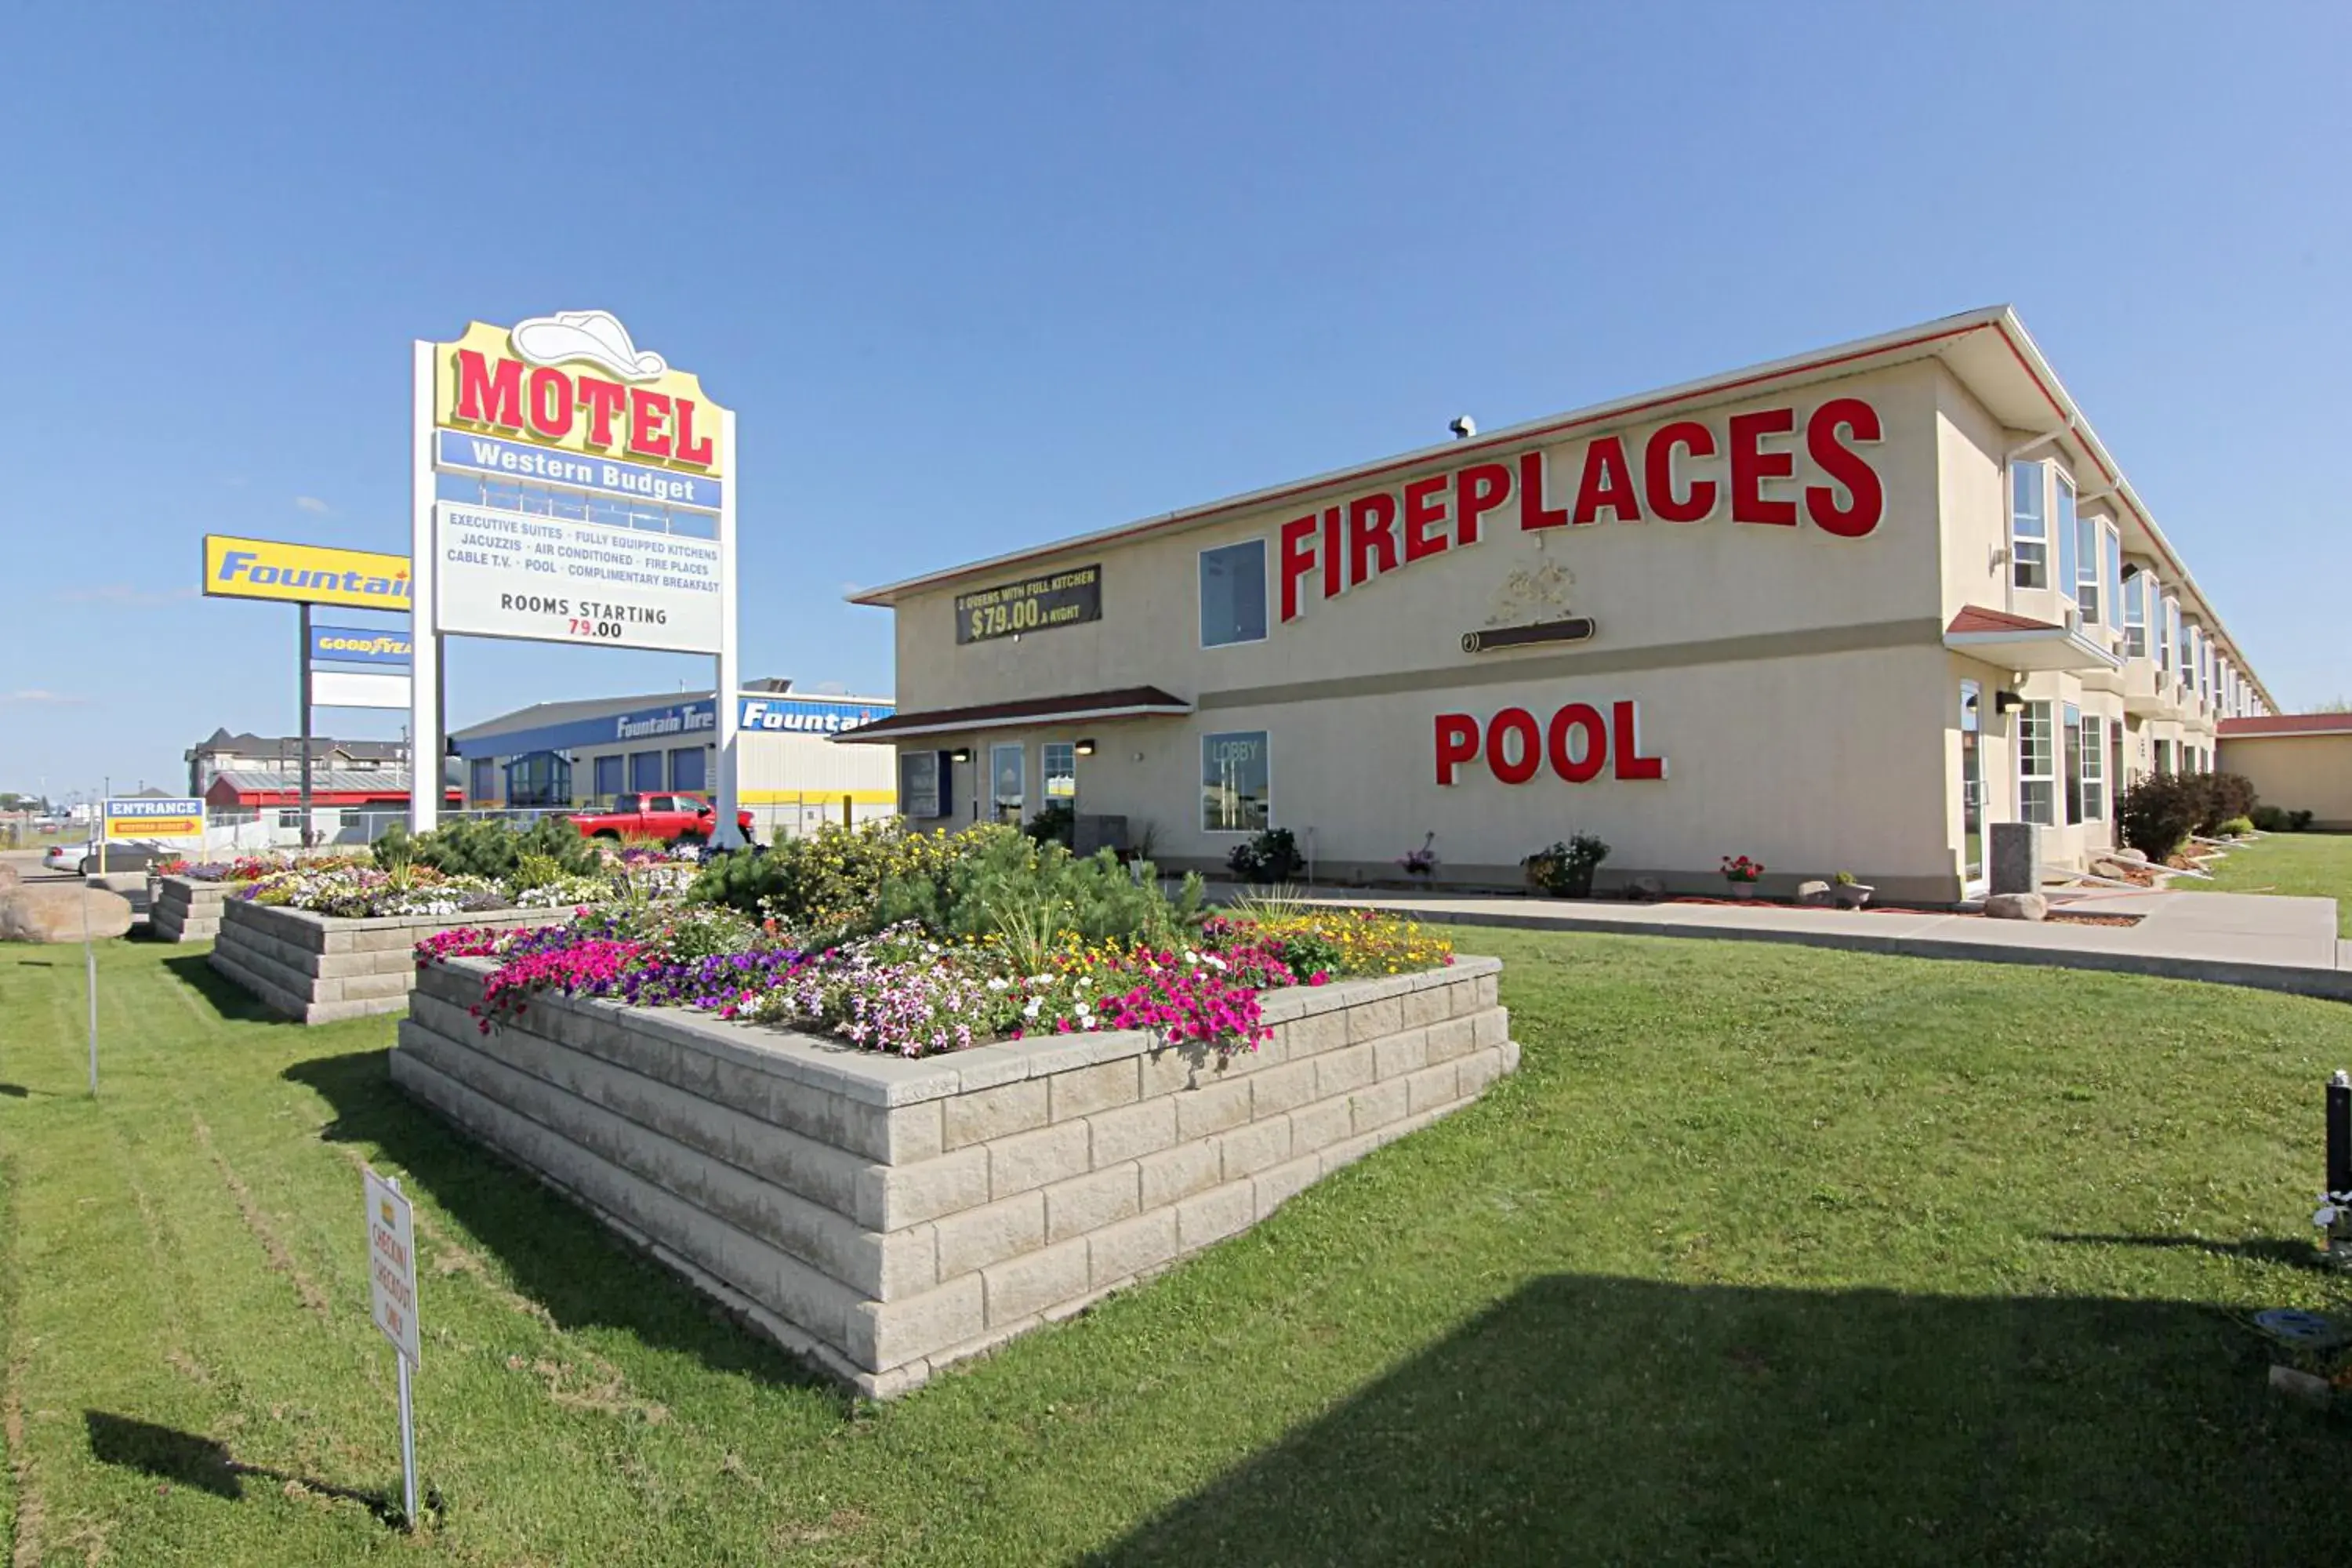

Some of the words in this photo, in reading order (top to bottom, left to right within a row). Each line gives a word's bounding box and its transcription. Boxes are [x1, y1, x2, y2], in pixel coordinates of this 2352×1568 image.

[456, 347, 713, 466] MOTEL
[472, 440, 593, 483] Western
[602, 465, 695, 502] Budget
[1280, 397, 1885, 625] FIREPLACES
[449, 512, 518, 534] EXECUTIVE
[521, 523, 562, 540] SUITES
[575, 531, 609, 546] FULLY
[612, 535, 665, 554] EQUIPPED
[667, 543, 718, 561] KITCHENS
[461, 533, 522, 551] JACUZZIS
[534, 543, 554, 556] AIR
[557, 545, 633, 565] CONDITIONED
[644, 557, 668, 571] FIRE
[670, 561, 709, 575] PLACES
[447, 549, 488, 565] CABLE
[491, 554, 512, 569] T.V.
[524, 558, 557, 573] POOL
[568, 564, 660, 586] COMPLIMENTARY
[662, 575, 720, 593] BREAKFAST
[1001, 585, 1025, 602] WITH
[1026, 580, 1050, 597] FULL
[1051, 570, 1095, 590] KITCHEN
[500, 593, 570, 615] ROOMS
[579, 600, 667, 626] STARTING
[568, 618, 622, 638] 79.00
[971, 598, 1038, 640] $79.00
[318, 636, 412, 655] GOODYEA
[617, 709, 681, 739] Fountain
[683, 706, 714, 730] Tire
[743, 702, 880, 733] Fountai
[1213, 740, 1258, 763] LOBBY
[1434, 699, 1668, 786] POOL
[112, 802, 196, 815] ENTRANCE
